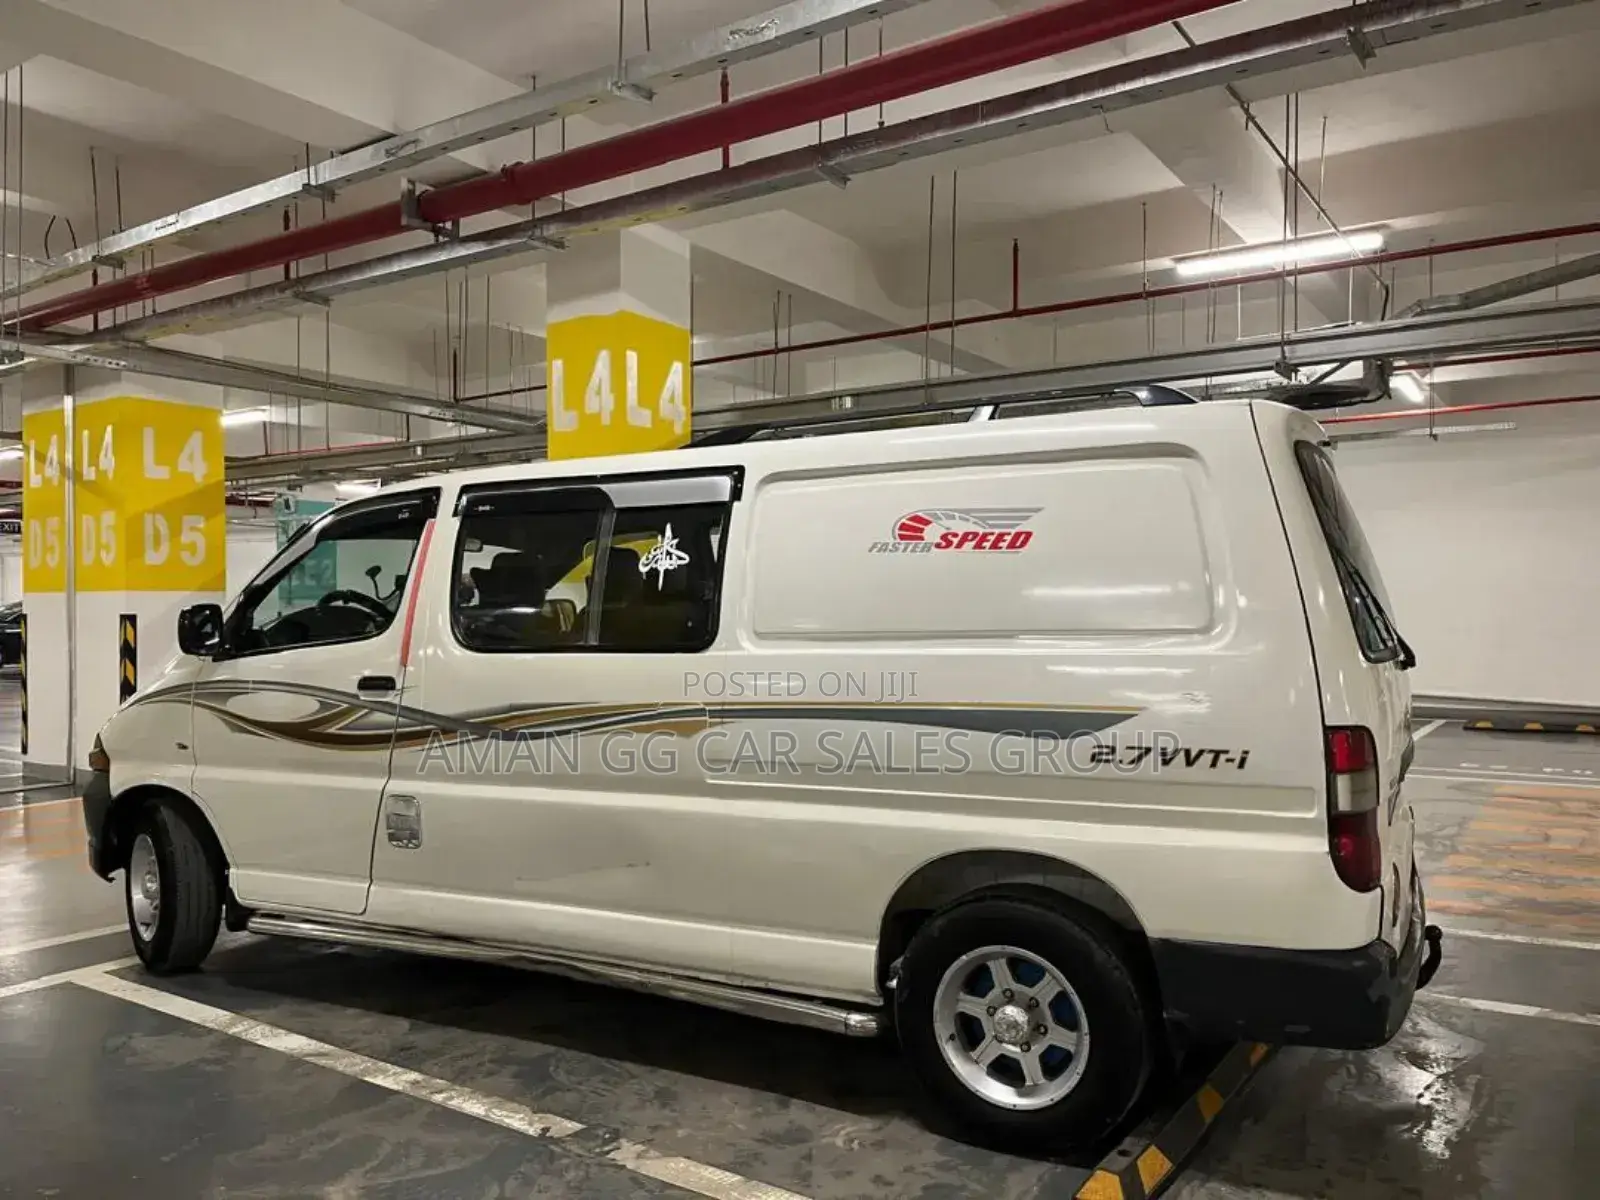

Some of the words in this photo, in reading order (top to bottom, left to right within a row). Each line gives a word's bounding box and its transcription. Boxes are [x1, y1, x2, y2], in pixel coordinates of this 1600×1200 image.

[552, 349, 615, 432] L4
[626, 349, 686, 435] L4
[28, 434, 60, 488] L4
[82, 424, 115, 481] L4
[142, 426, 208, 483] L4
[28, 516, 60, 570] D5
[81, 510, 117, 567] D5
[142, 511, 207, 566] D5
[867, 541, 934, 554] FASTER
[933, 530, 1034, 551] SPEED
